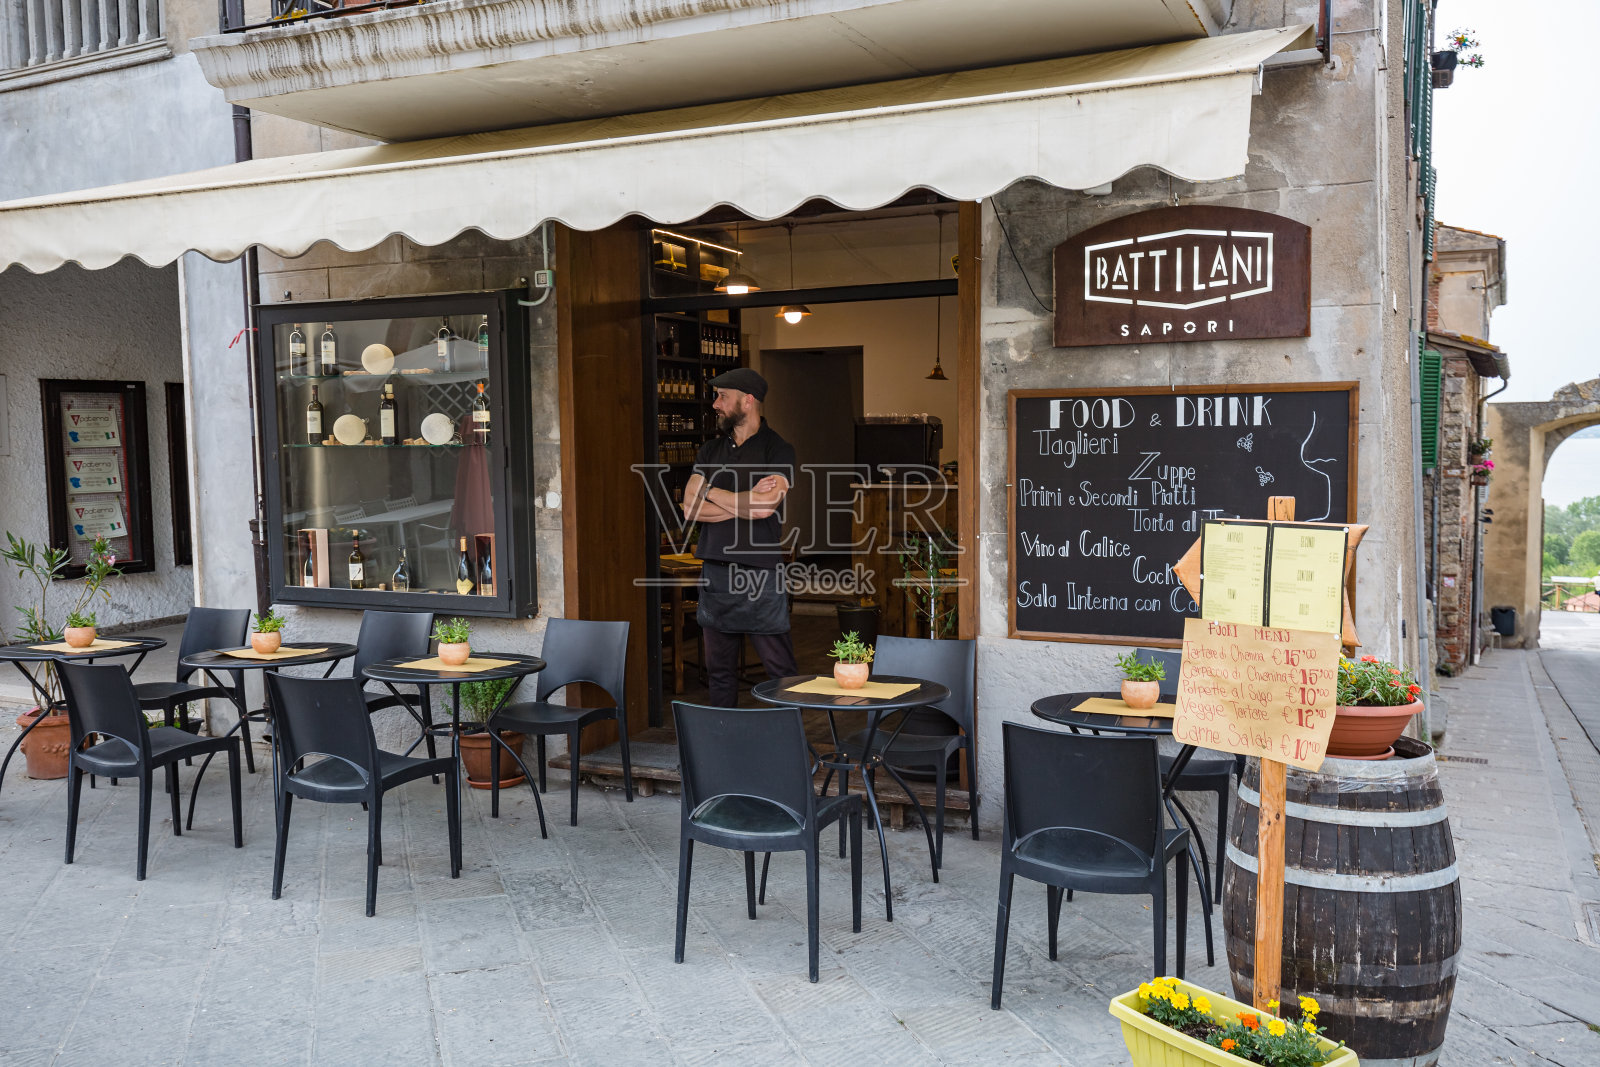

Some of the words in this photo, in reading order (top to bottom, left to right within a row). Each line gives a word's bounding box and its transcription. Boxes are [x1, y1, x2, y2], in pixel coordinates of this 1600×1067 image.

[1096, 244, 1262, 292] BATTILANI
[1120, 319, 1234, 337] SAPORI
[1050, 398, 1135, 428] FOOD
[1149, 413, 1162, 427] &
[1176, 395, 1272, 427] DRINK
[1032, 429, 1119, 468] Taglieri
[1128, 451, 1196, 488] Zuppe
[1020, 479, 1062, 506] Primi
[1068, 495, 1076, 505] e
[1079, 481, 1138, 506] Secondi
[1151, 481, 1197, 506] Piatti
[1127, 509, 1174, 532] Torta
[1181, 511, 1197, 532] al
[1021, 531, 1055, 557] Vino
[1058, 540, 1070, 557] al
[1079, 530, 1131, 557] Calice
[1017, 581, 1057, 607] Sala
[1066, 582, 1128, 611] Interna
[1135, 599, 1161, 611] con
[1183, 640, 1218, 660] Tartare
[1182, 679, 1228, 699] Polpette
[1247, 683, 1273, 707] Sugo
[1180, 697, 1227, 721] Veggie
[1176, 715, 1222, 745] Carne
